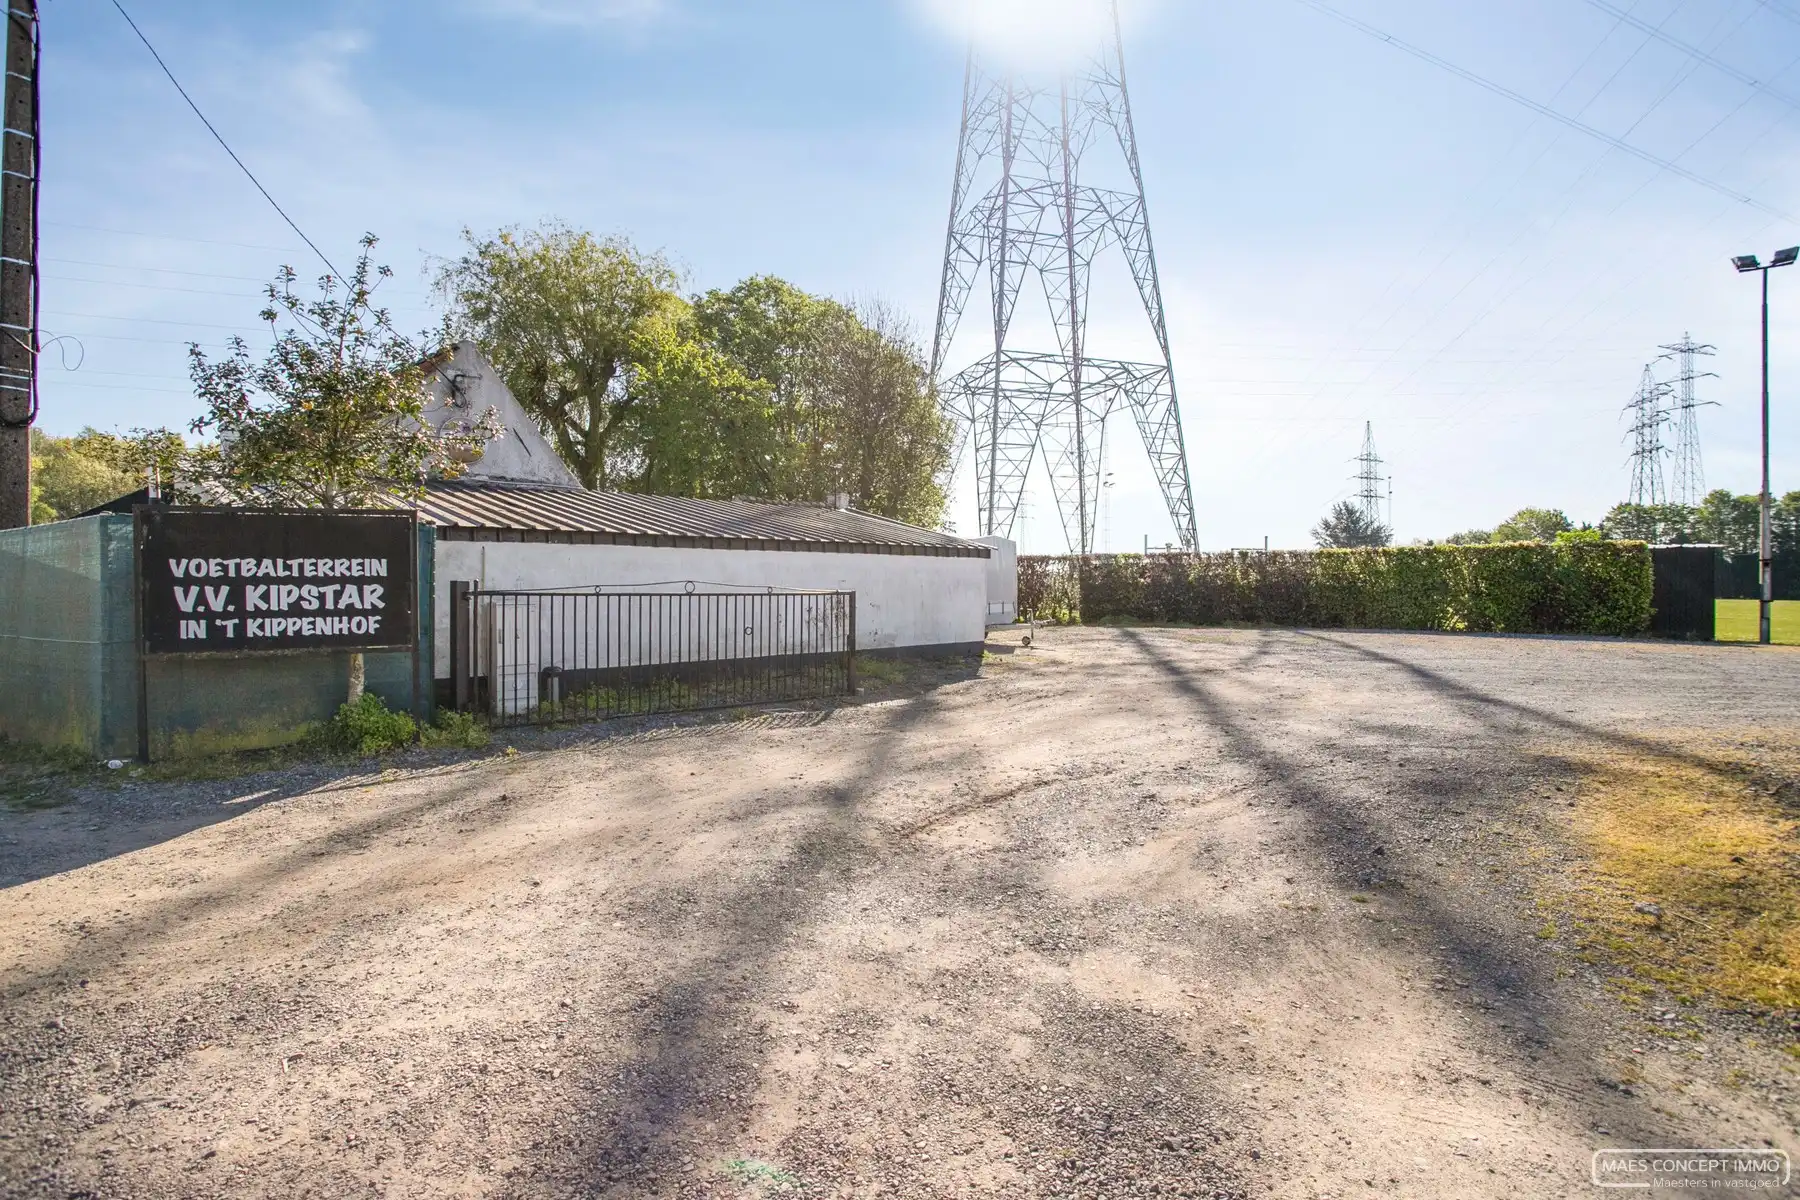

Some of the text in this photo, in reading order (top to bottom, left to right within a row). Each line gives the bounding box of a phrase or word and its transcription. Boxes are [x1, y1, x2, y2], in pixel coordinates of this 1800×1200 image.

[168, 558, 388, 578] VOETBALTERREIN
[173, 583, 386, 613] V.V. KIPSTAR
[179, 620, 207, 640] IN
[246, 615, 382, 638] KIPPENHOF
